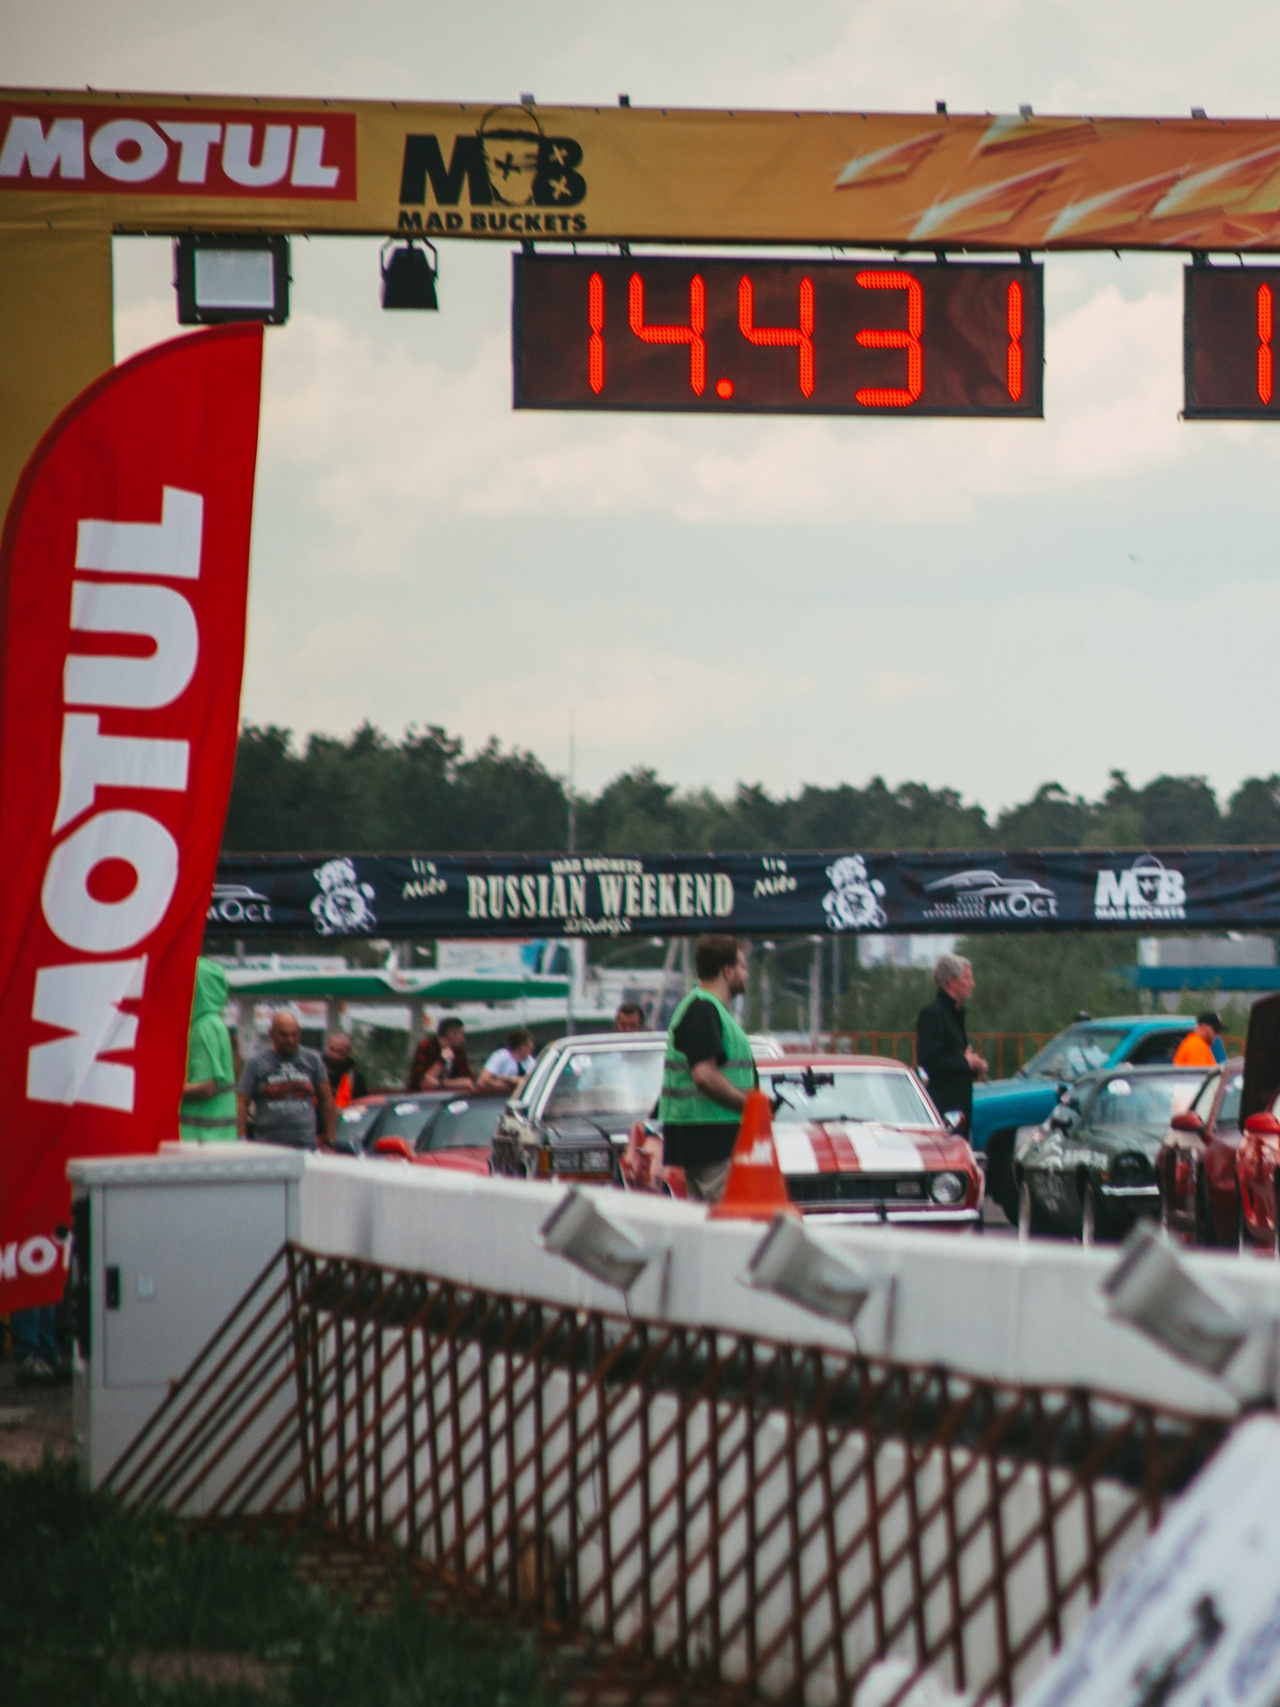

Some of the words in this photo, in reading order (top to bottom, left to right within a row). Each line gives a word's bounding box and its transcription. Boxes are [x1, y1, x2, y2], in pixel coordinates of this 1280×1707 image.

[1, 115, 340, 188] MOTUL
[399, 211, 464, 231] MAD
[470, 213, 587, 232] BUCKETS
[589, 271, 1023, 407] 14.431
[27, 486, 204, 1113] MOTUL
[466, 874, 587, 919] RUSSIAN
[598, 872, 735, 918] WEEKEND
